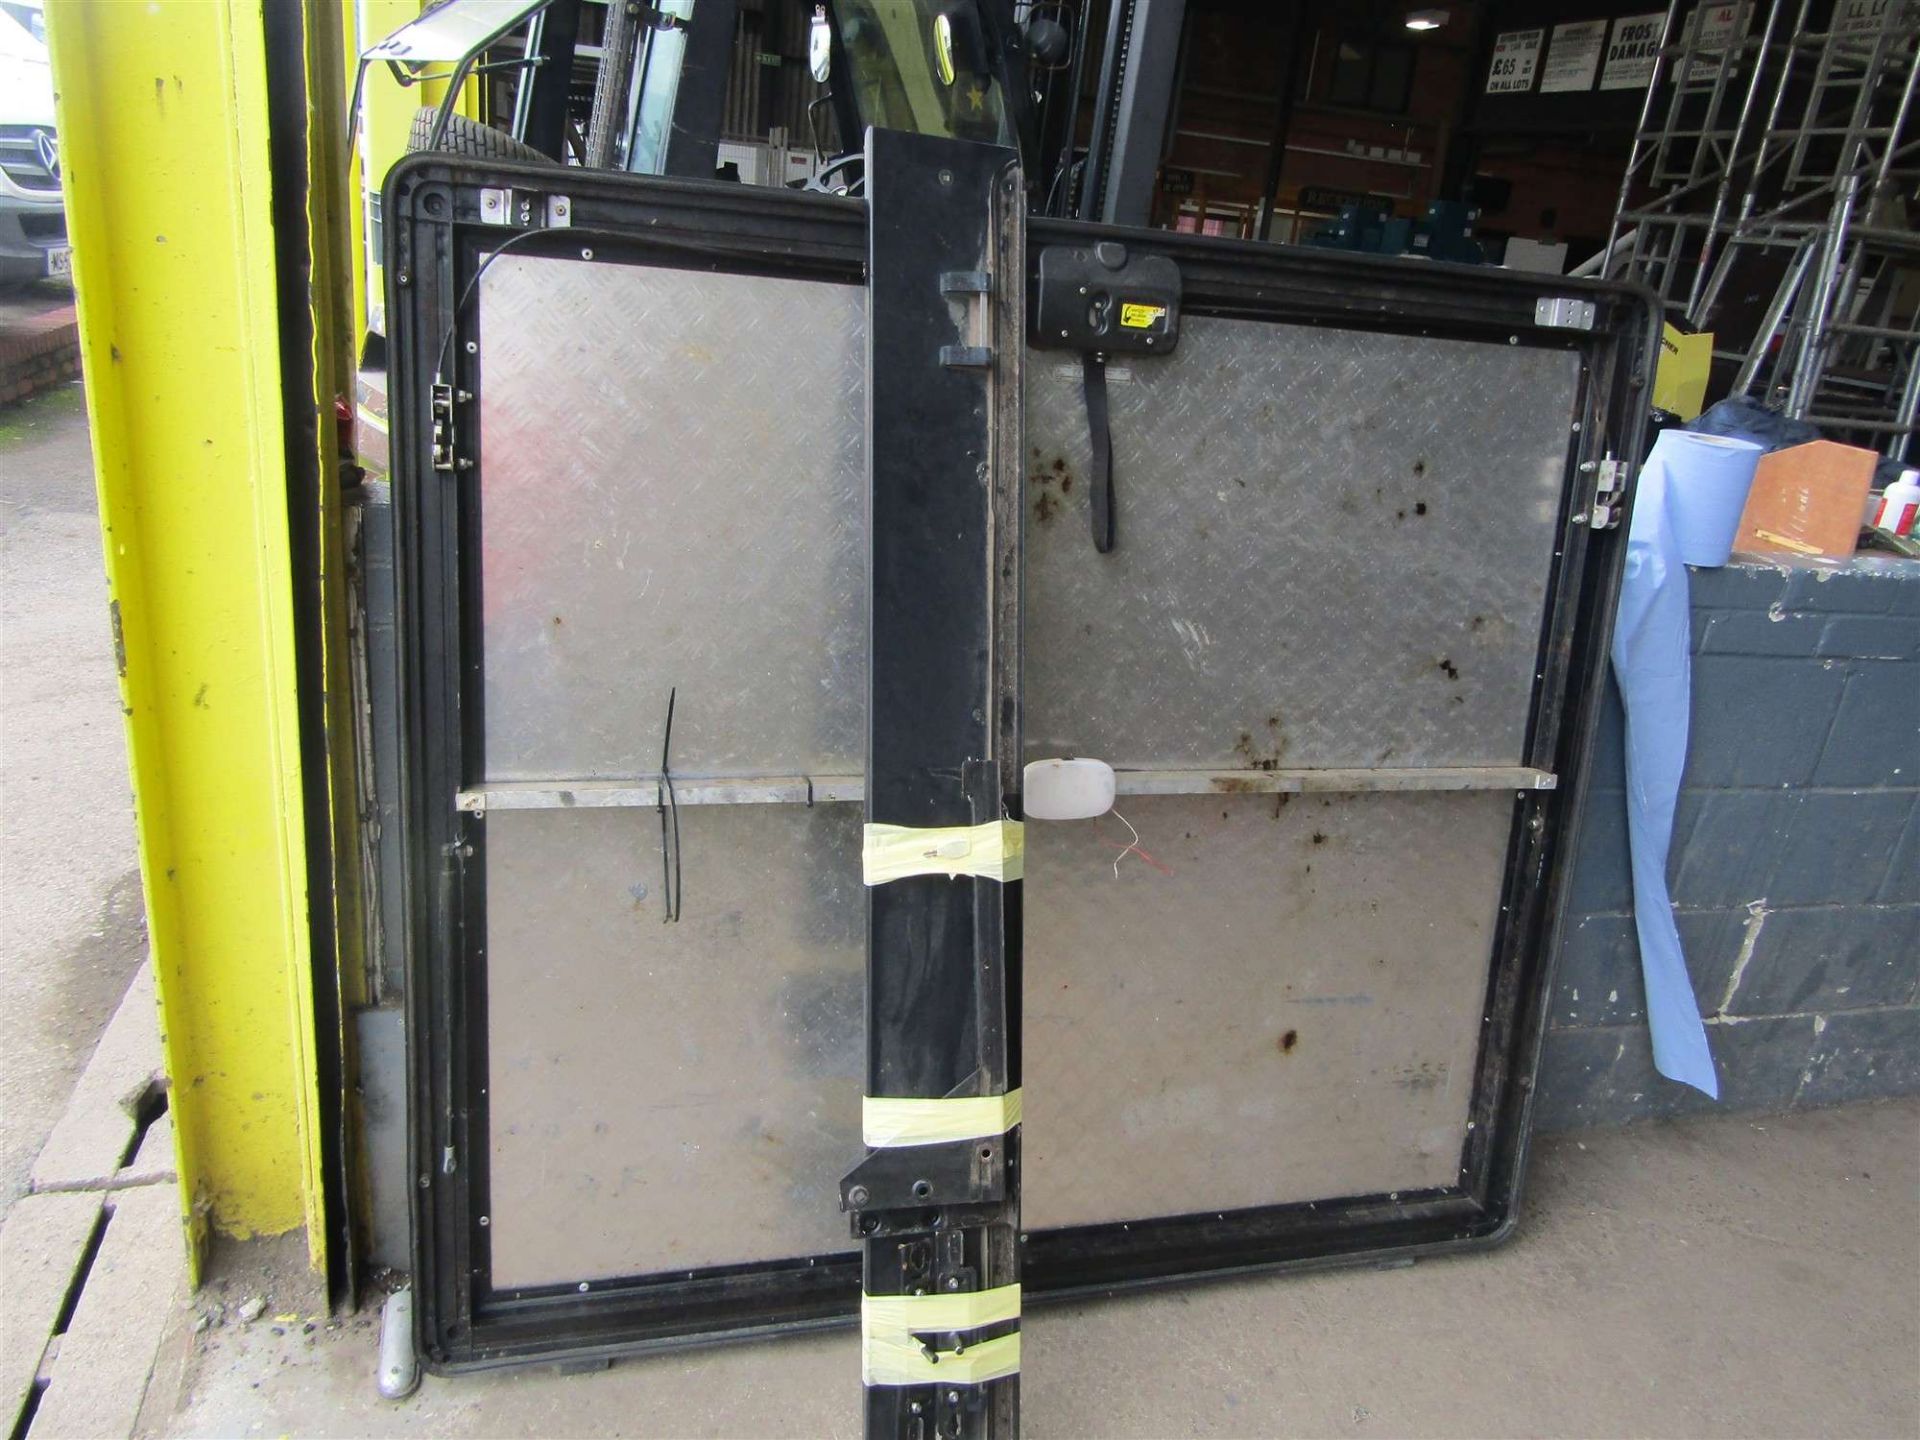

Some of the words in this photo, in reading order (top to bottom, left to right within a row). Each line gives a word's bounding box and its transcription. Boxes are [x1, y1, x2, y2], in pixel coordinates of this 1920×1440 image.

[1609, 41, 1661, 61] DAMAG
[1492, 58, 1517, 75] £65
[1490, 81, 1499, 90] ON
[1501, 80, 1511, 90] ALL
[1513, 79, 1529, 89] LOTS
